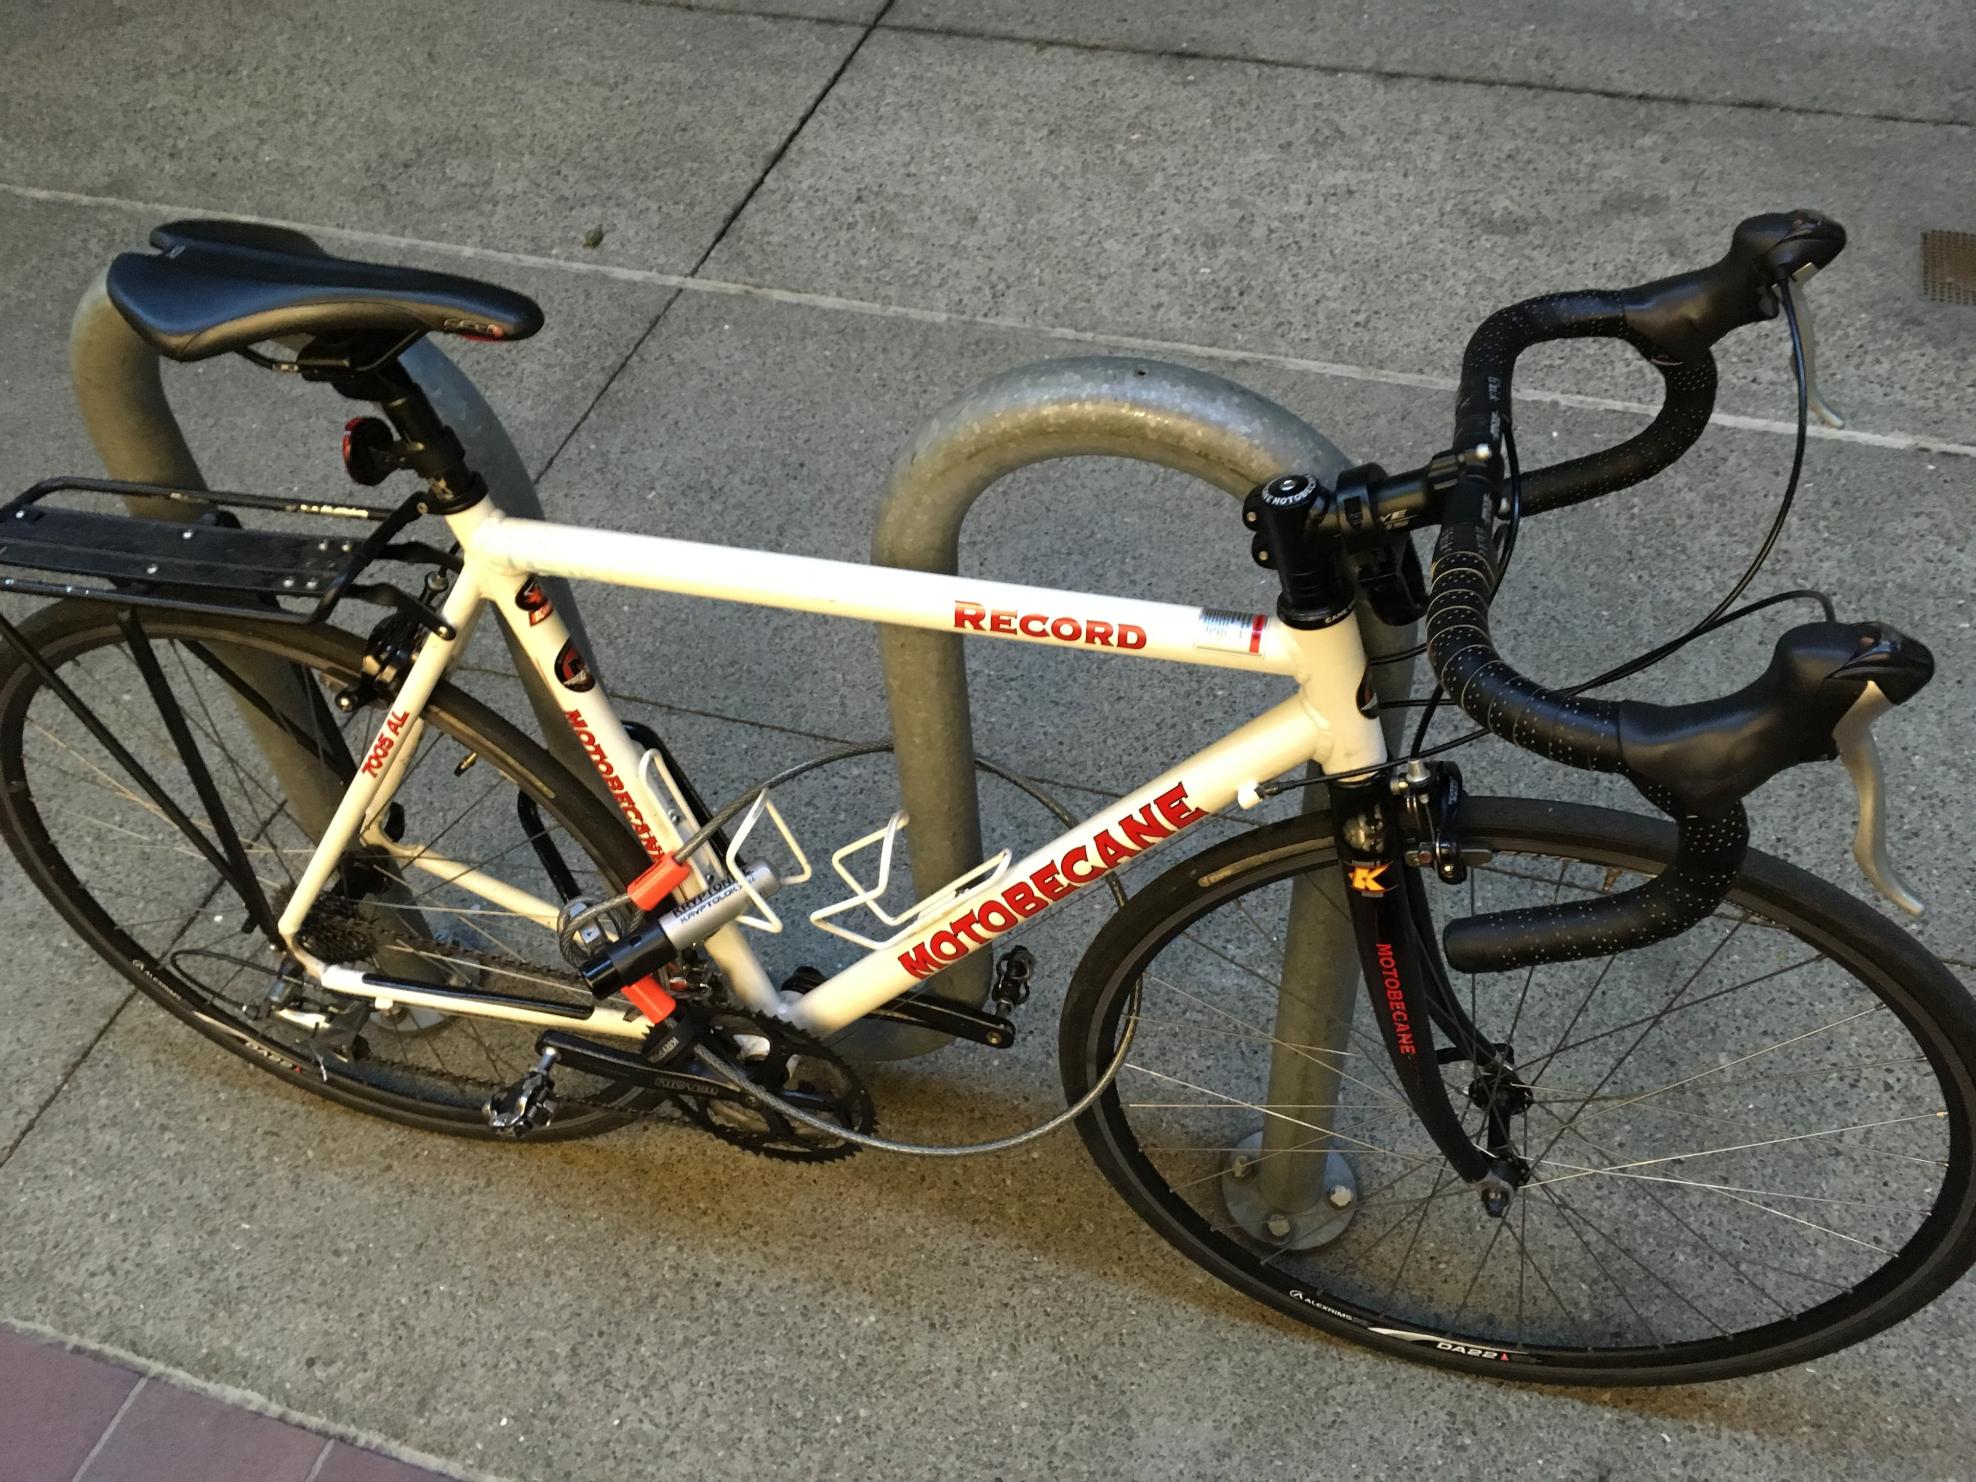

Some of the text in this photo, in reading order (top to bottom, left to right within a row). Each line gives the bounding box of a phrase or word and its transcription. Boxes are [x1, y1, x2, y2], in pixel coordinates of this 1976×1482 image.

[953, 600, 1148, 650] RECORD
[361, 711, 410, 779] 7005 AL
[564, 709, 666, 864] MOTOBECAN
[897, 781, 1209, 979] MOTOBECANE
[1375, 943, 1417, 1056] MOTOBECANE
[1436, 1342, 1499, 1359] DA22
